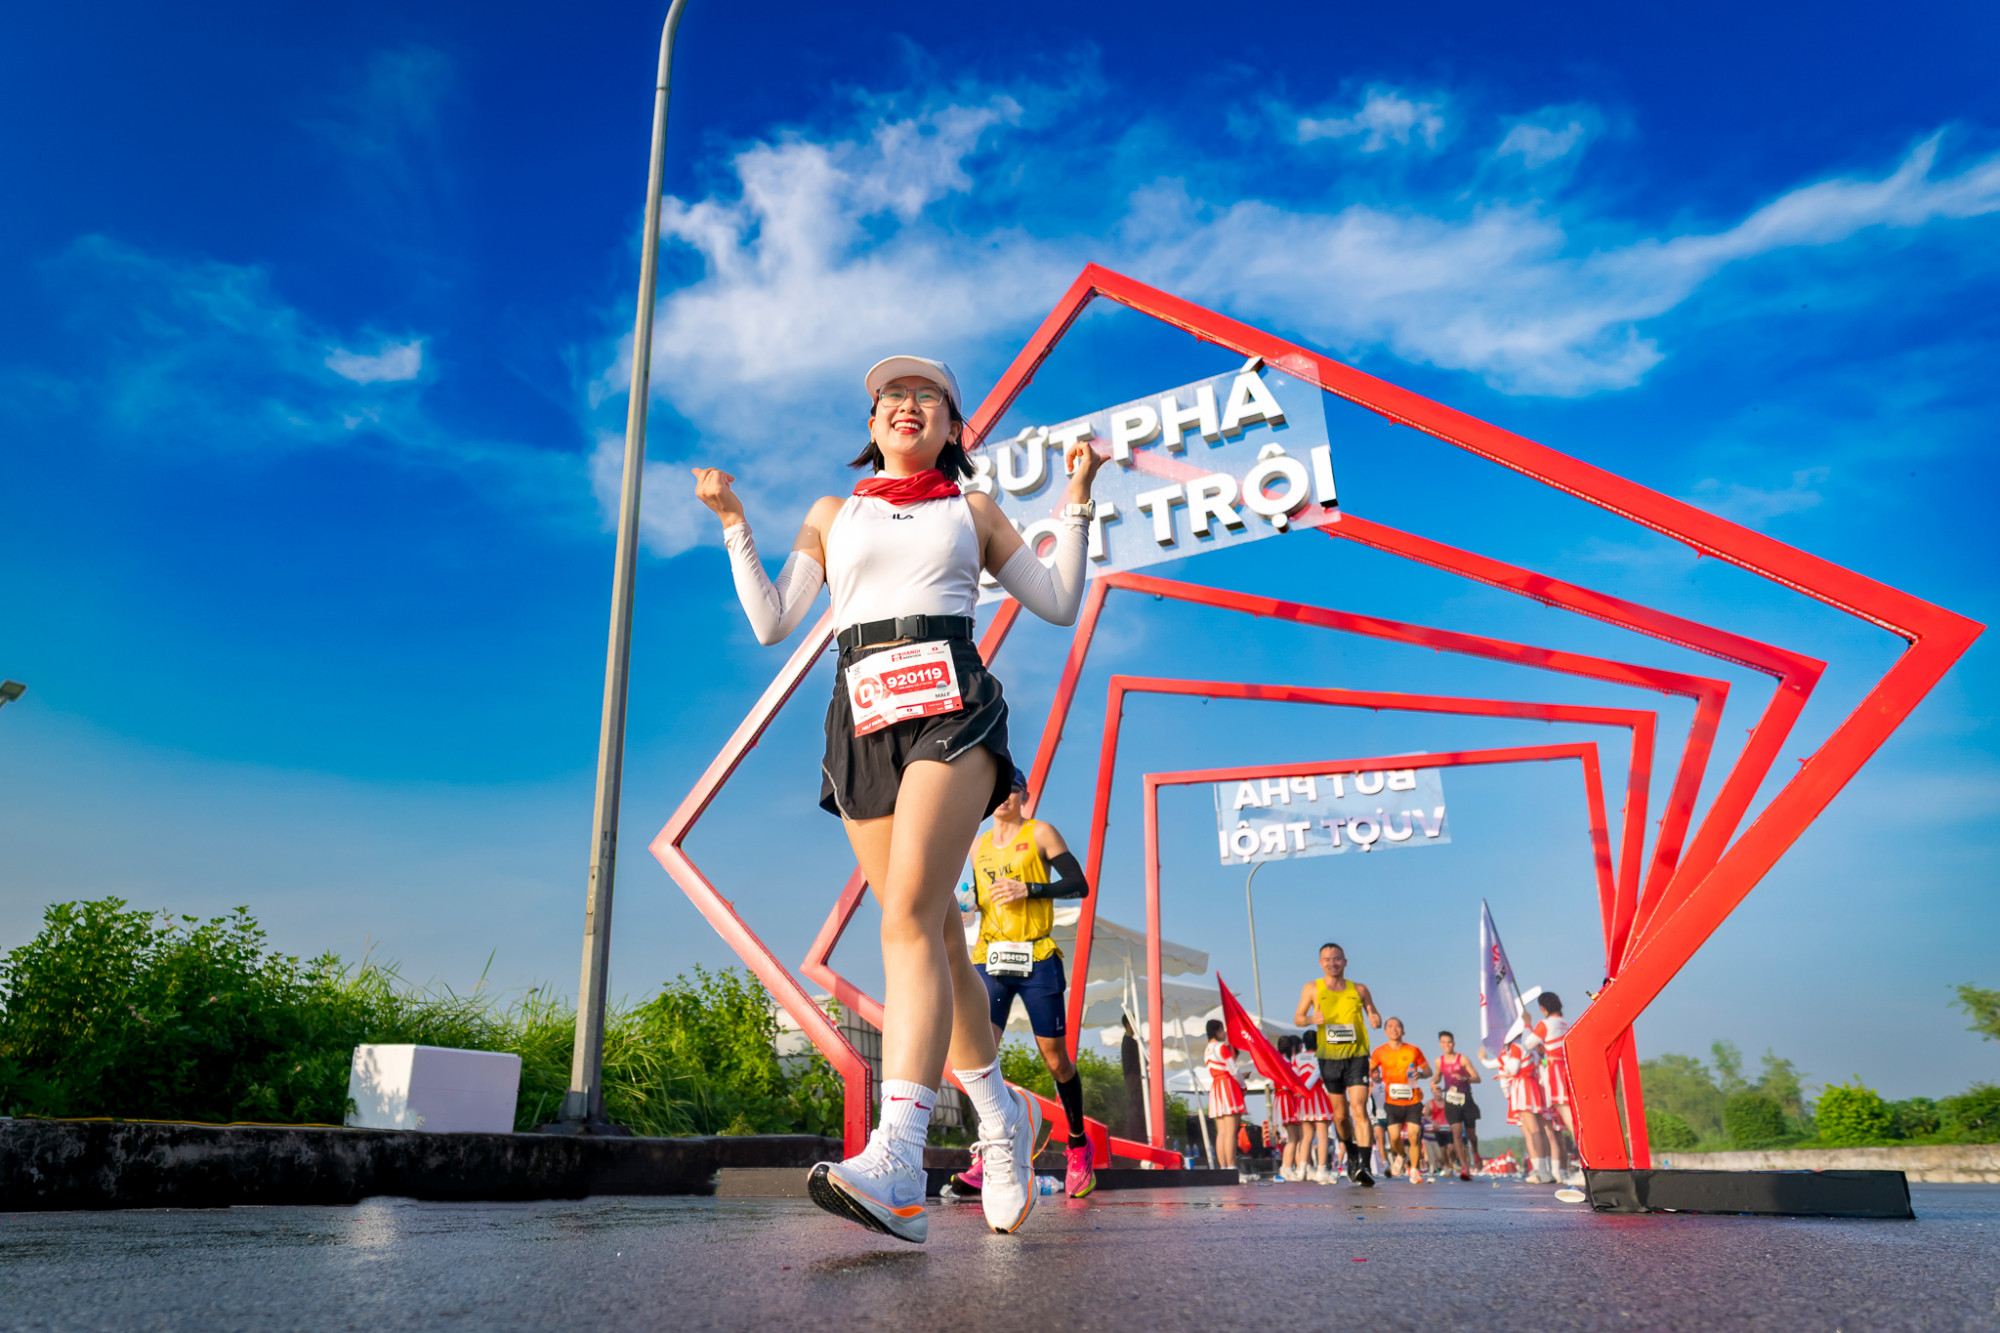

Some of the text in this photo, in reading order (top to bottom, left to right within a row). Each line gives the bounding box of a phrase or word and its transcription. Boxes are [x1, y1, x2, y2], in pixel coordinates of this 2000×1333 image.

[1111, 356, 1287, 468] PHÁ
[1136, 443, 1339, 546] TRỘI
[886, 667, 943, 689] 920119
